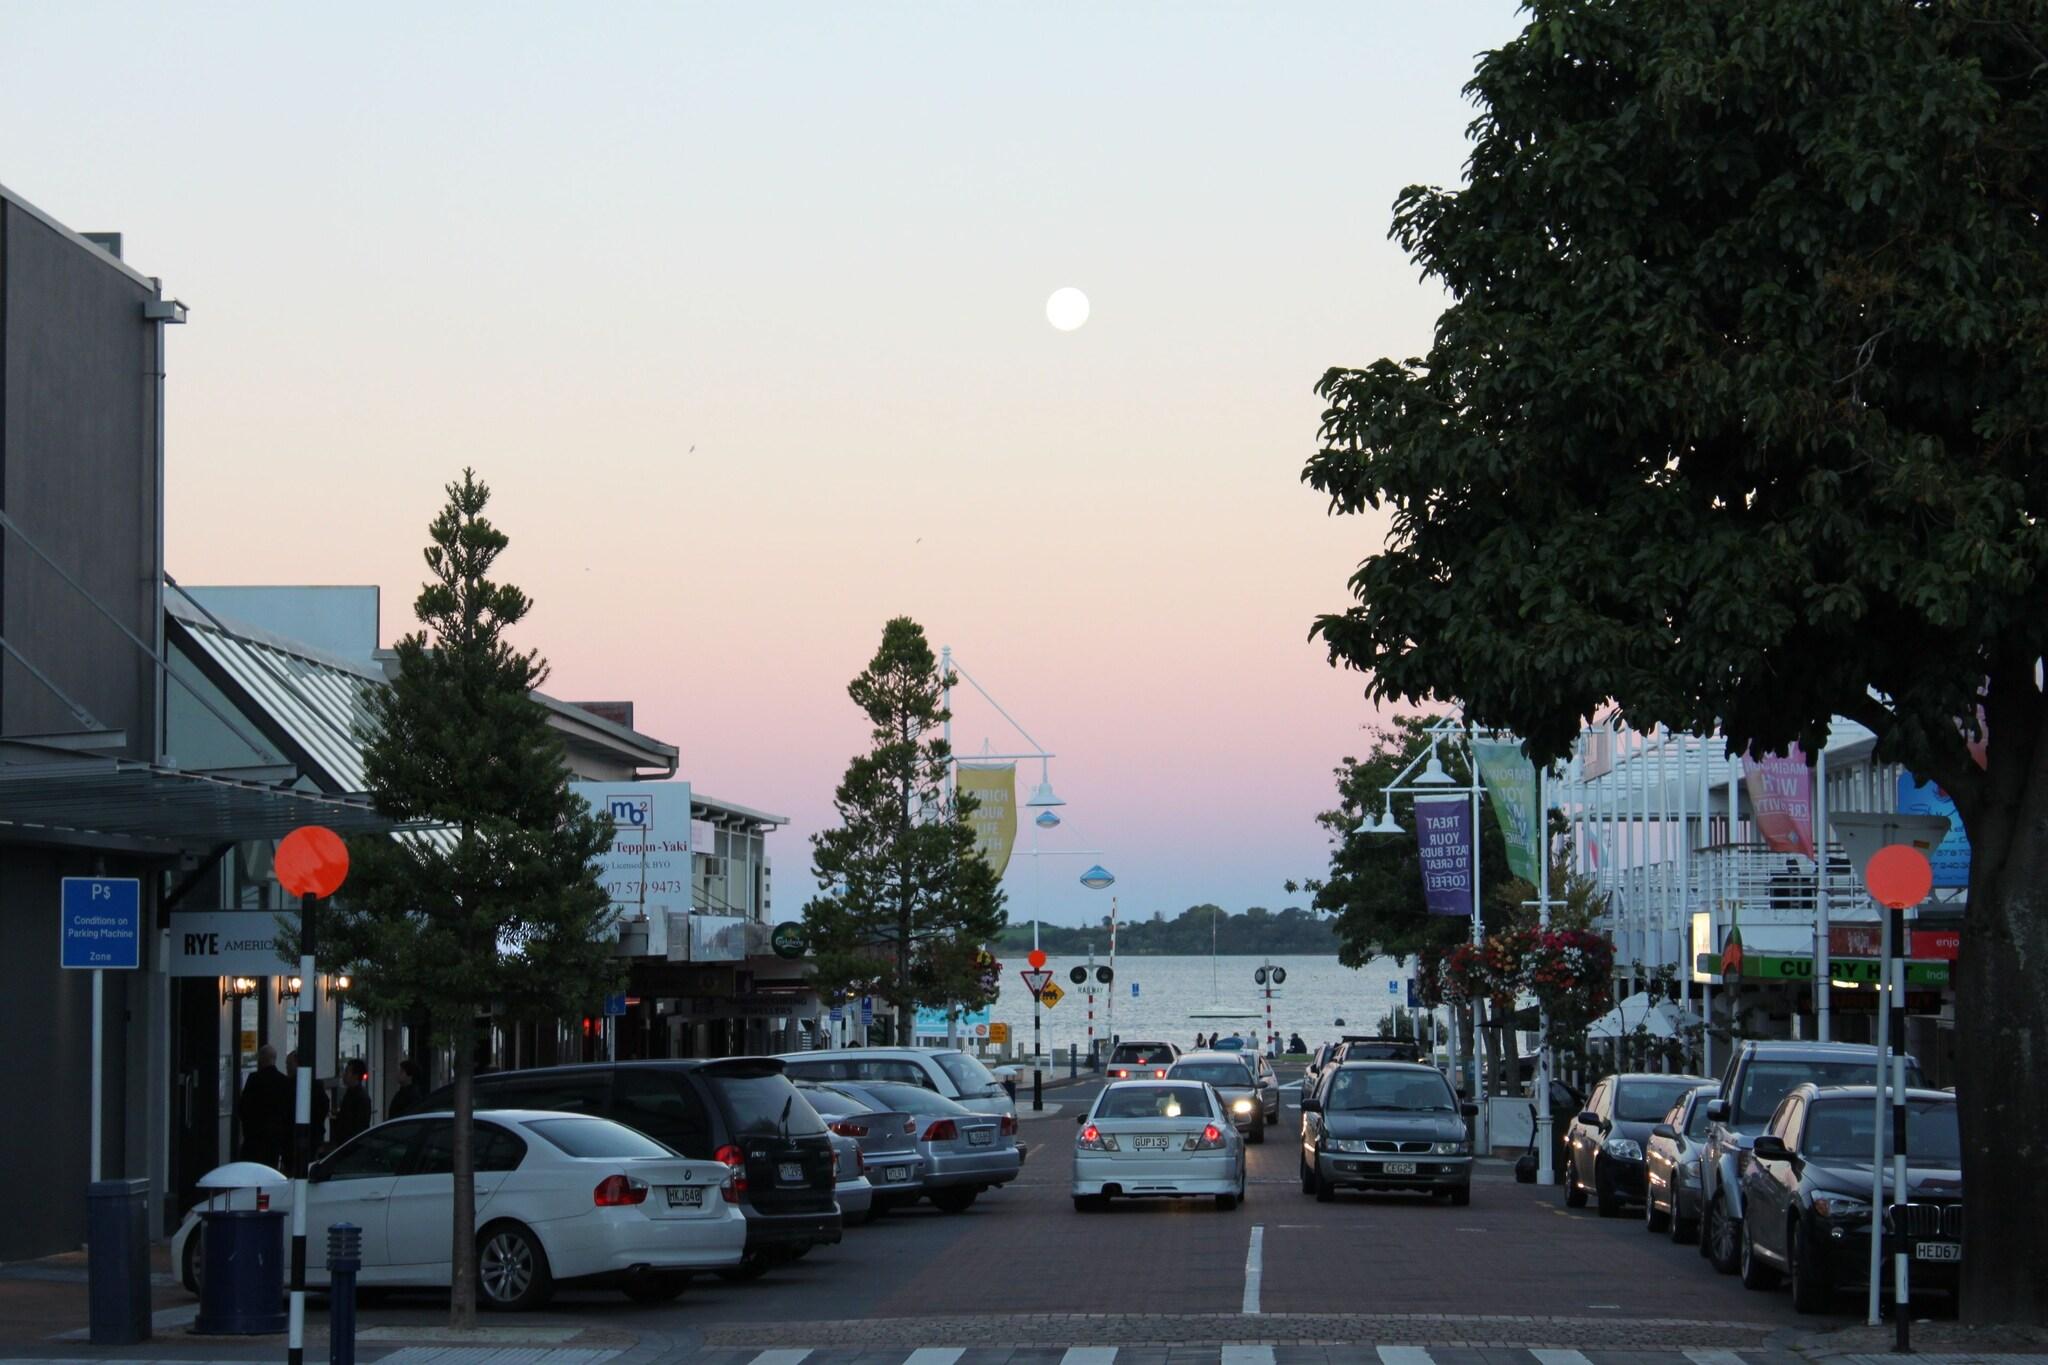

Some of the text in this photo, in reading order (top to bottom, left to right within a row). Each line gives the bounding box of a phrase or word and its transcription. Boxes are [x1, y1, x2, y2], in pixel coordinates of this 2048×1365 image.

[653, 860, 672, 870] BYO
[607, 880, 681, 895] 07 579 9473
[74, 915, 128, 926] Conditions on
[68, 928, 134, 940] Parking Machine
[184, 933, 219, 955] RYE
[89, 951, 112, 961] Zone
[1780, 960, 1913, 981] CURY HT
[1135, 1136, 1168, 1148] GUP135
[1918, 1244, 1960, 1259] HED67
